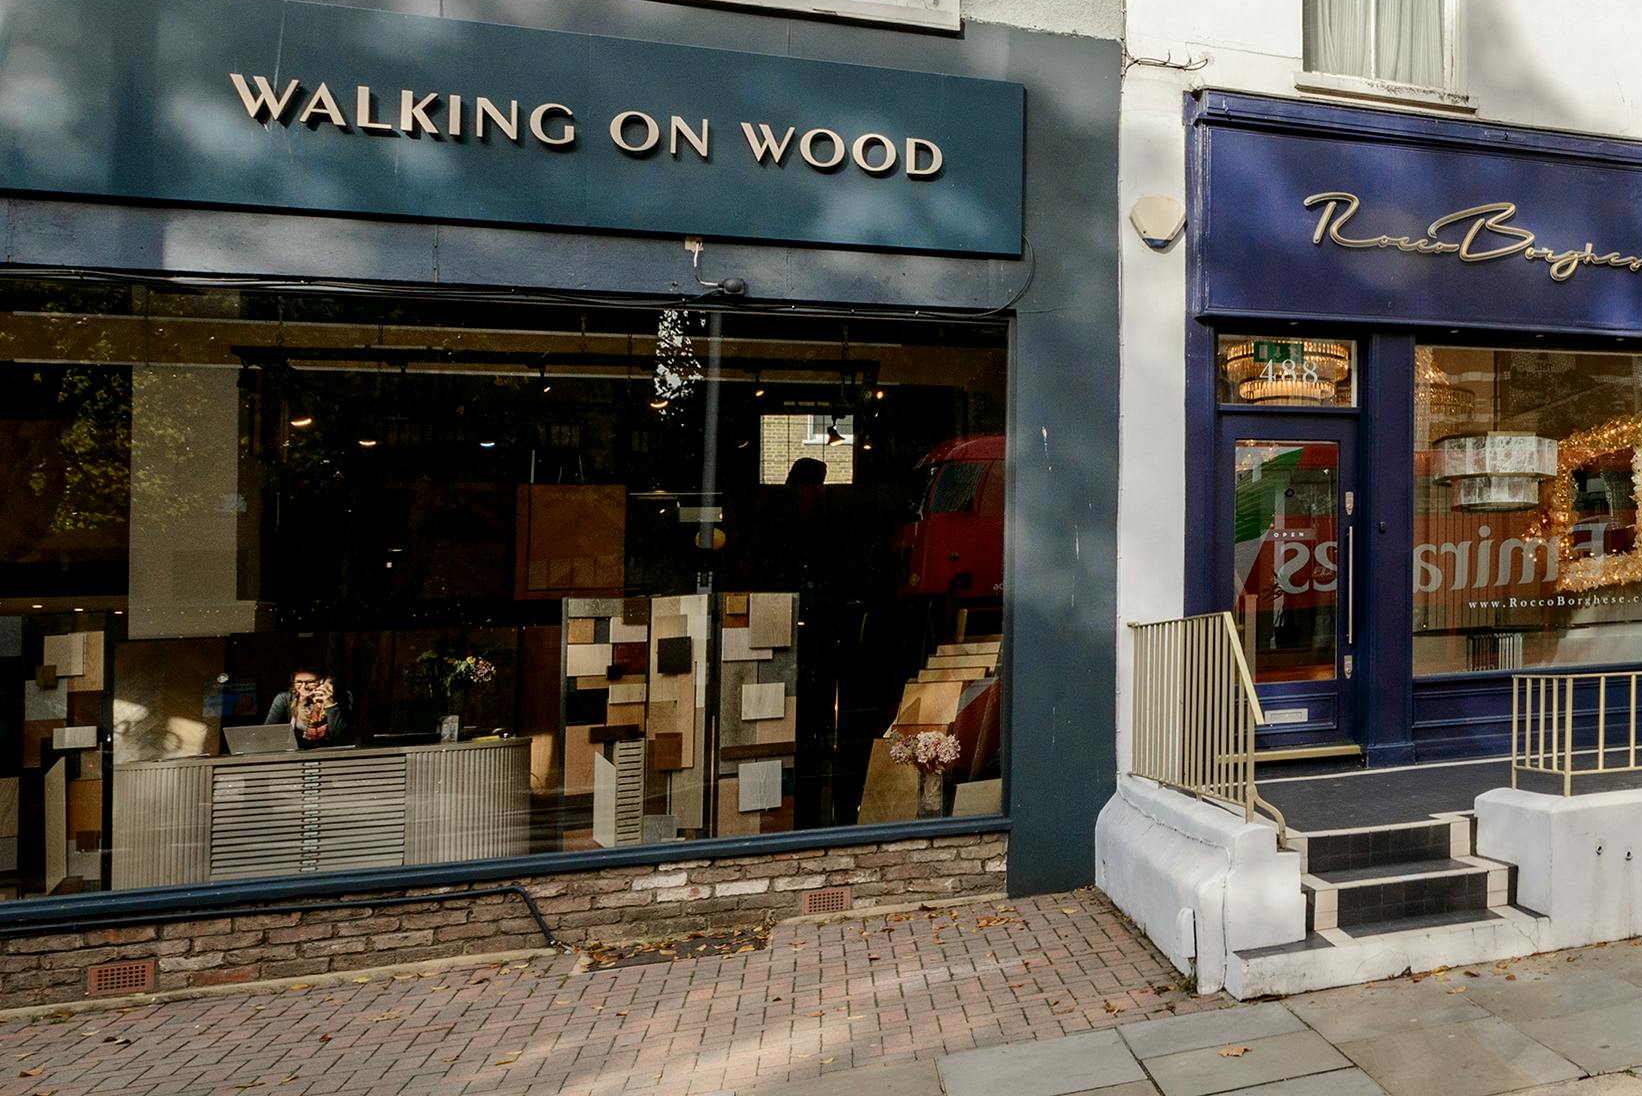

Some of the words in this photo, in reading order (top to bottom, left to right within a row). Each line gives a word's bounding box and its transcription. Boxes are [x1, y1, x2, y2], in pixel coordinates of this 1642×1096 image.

[230, 73, 575, 145] WALKING
[609, 110, 709, 158] ON
[740, 121, 944, 177] WOOD
[1303, 192, 1461, 253] Rocco
[1260, 359, 1318, 385] 488
